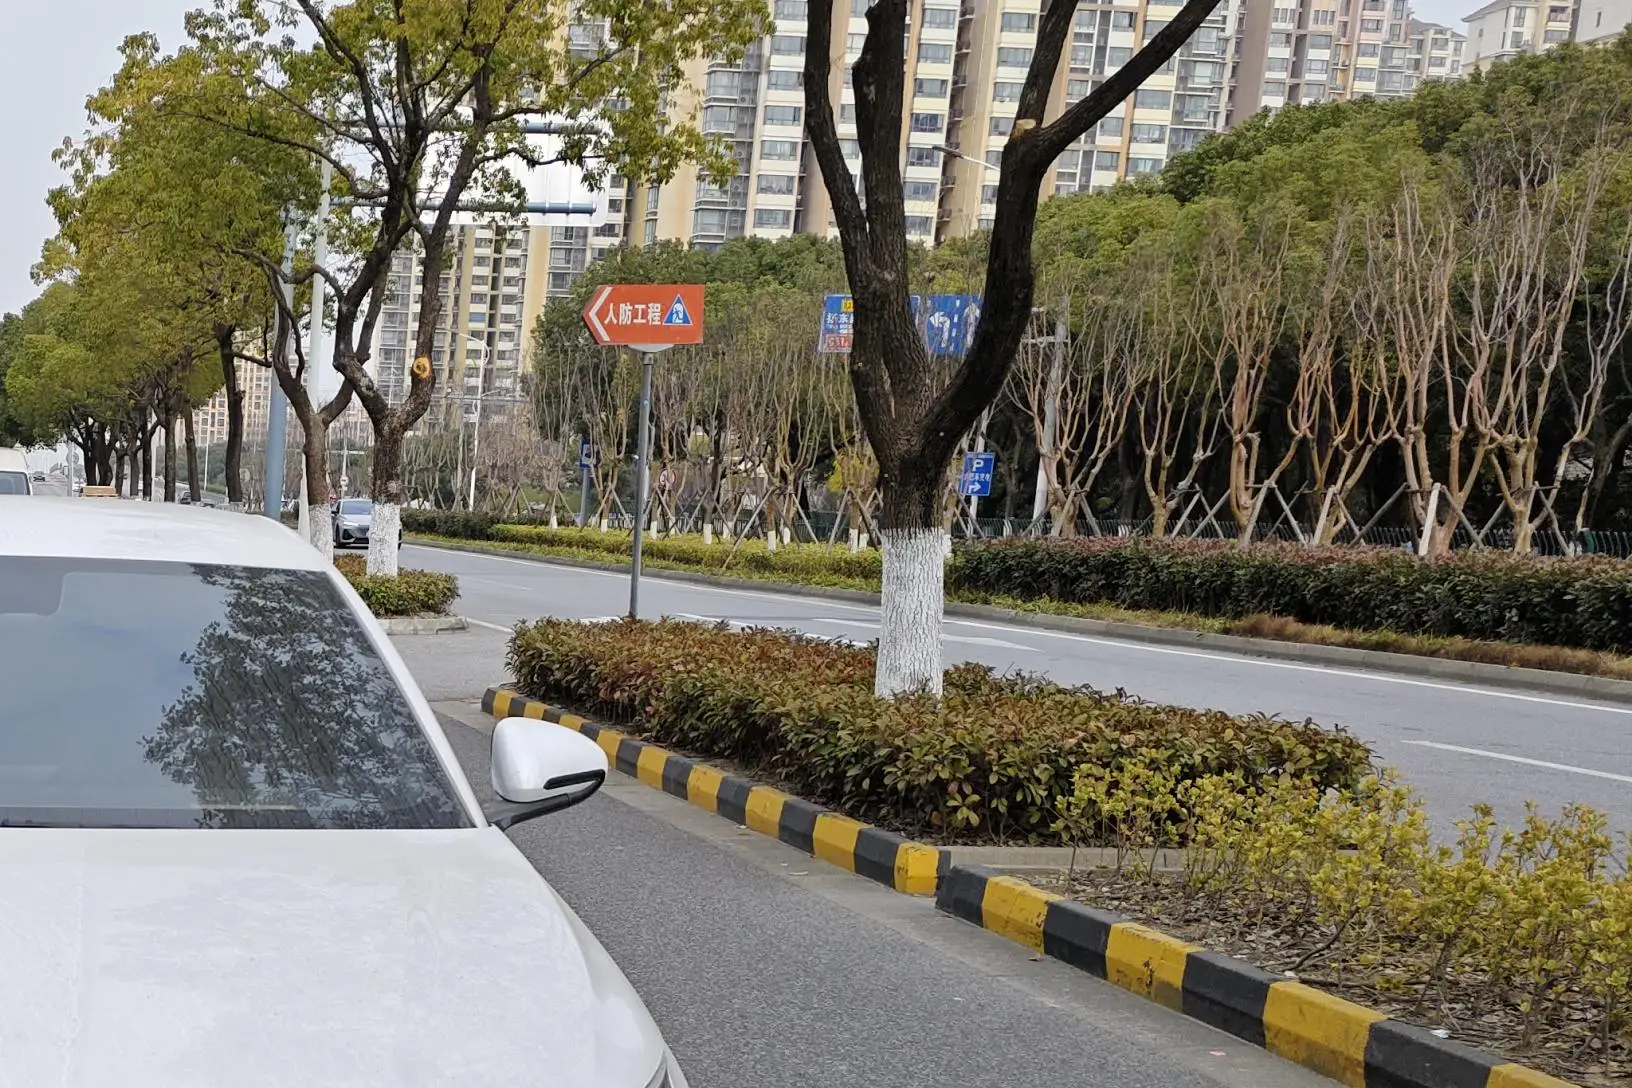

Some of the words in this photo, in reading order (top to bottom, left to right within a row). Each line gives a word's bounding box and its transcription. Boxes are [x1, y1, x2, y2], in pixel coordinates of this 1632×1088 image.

[604, 302, 662, 325] 人防工程
[972, 459, 984, 471] P
